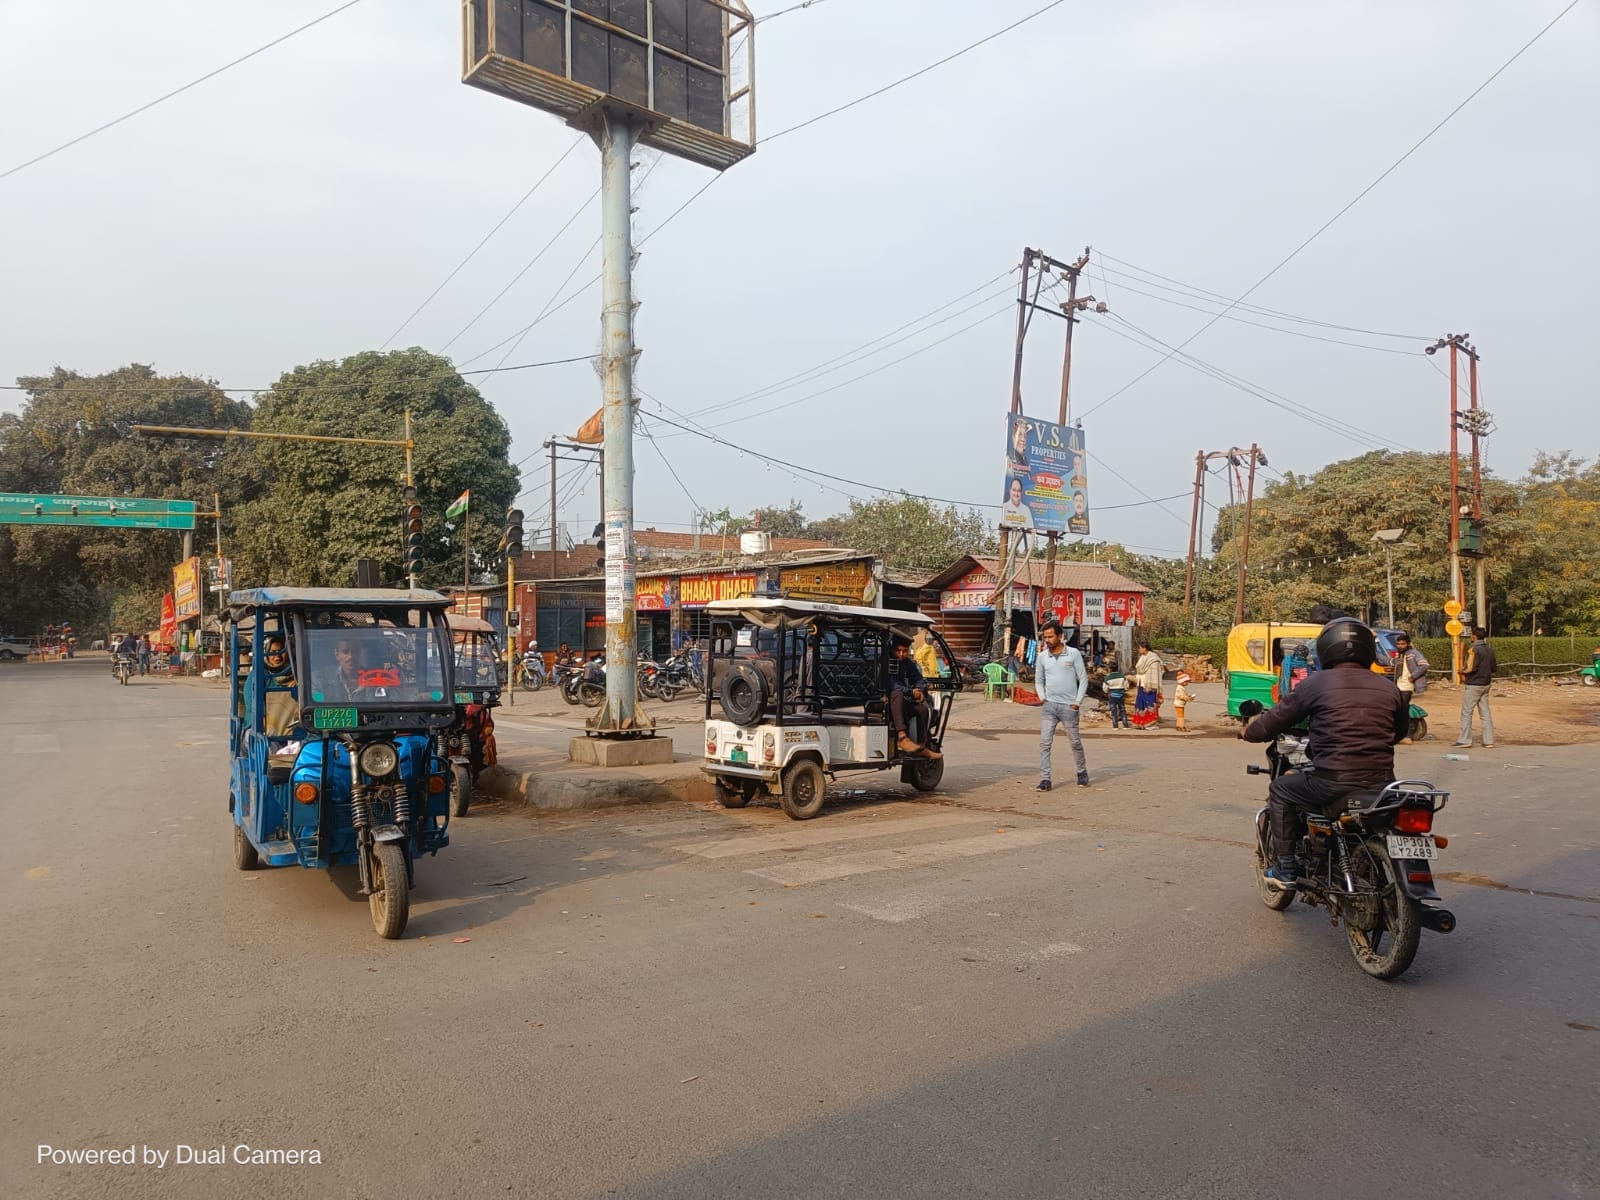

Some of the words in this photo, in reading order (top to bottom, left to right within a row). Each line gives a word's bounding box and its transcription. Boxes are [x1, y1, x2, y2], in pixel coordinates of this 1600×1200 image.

[1034, 422, 1064, 448] V.S.
[1031, 445, 1066, 460] PROPERTIES
[680, 581, 718, 602] BHARAT
[1085, 597, 1103, 607] BHARAT
[321, 709, 352, 718] UP27C
[1396, 837, 1431, 848] UP30A
